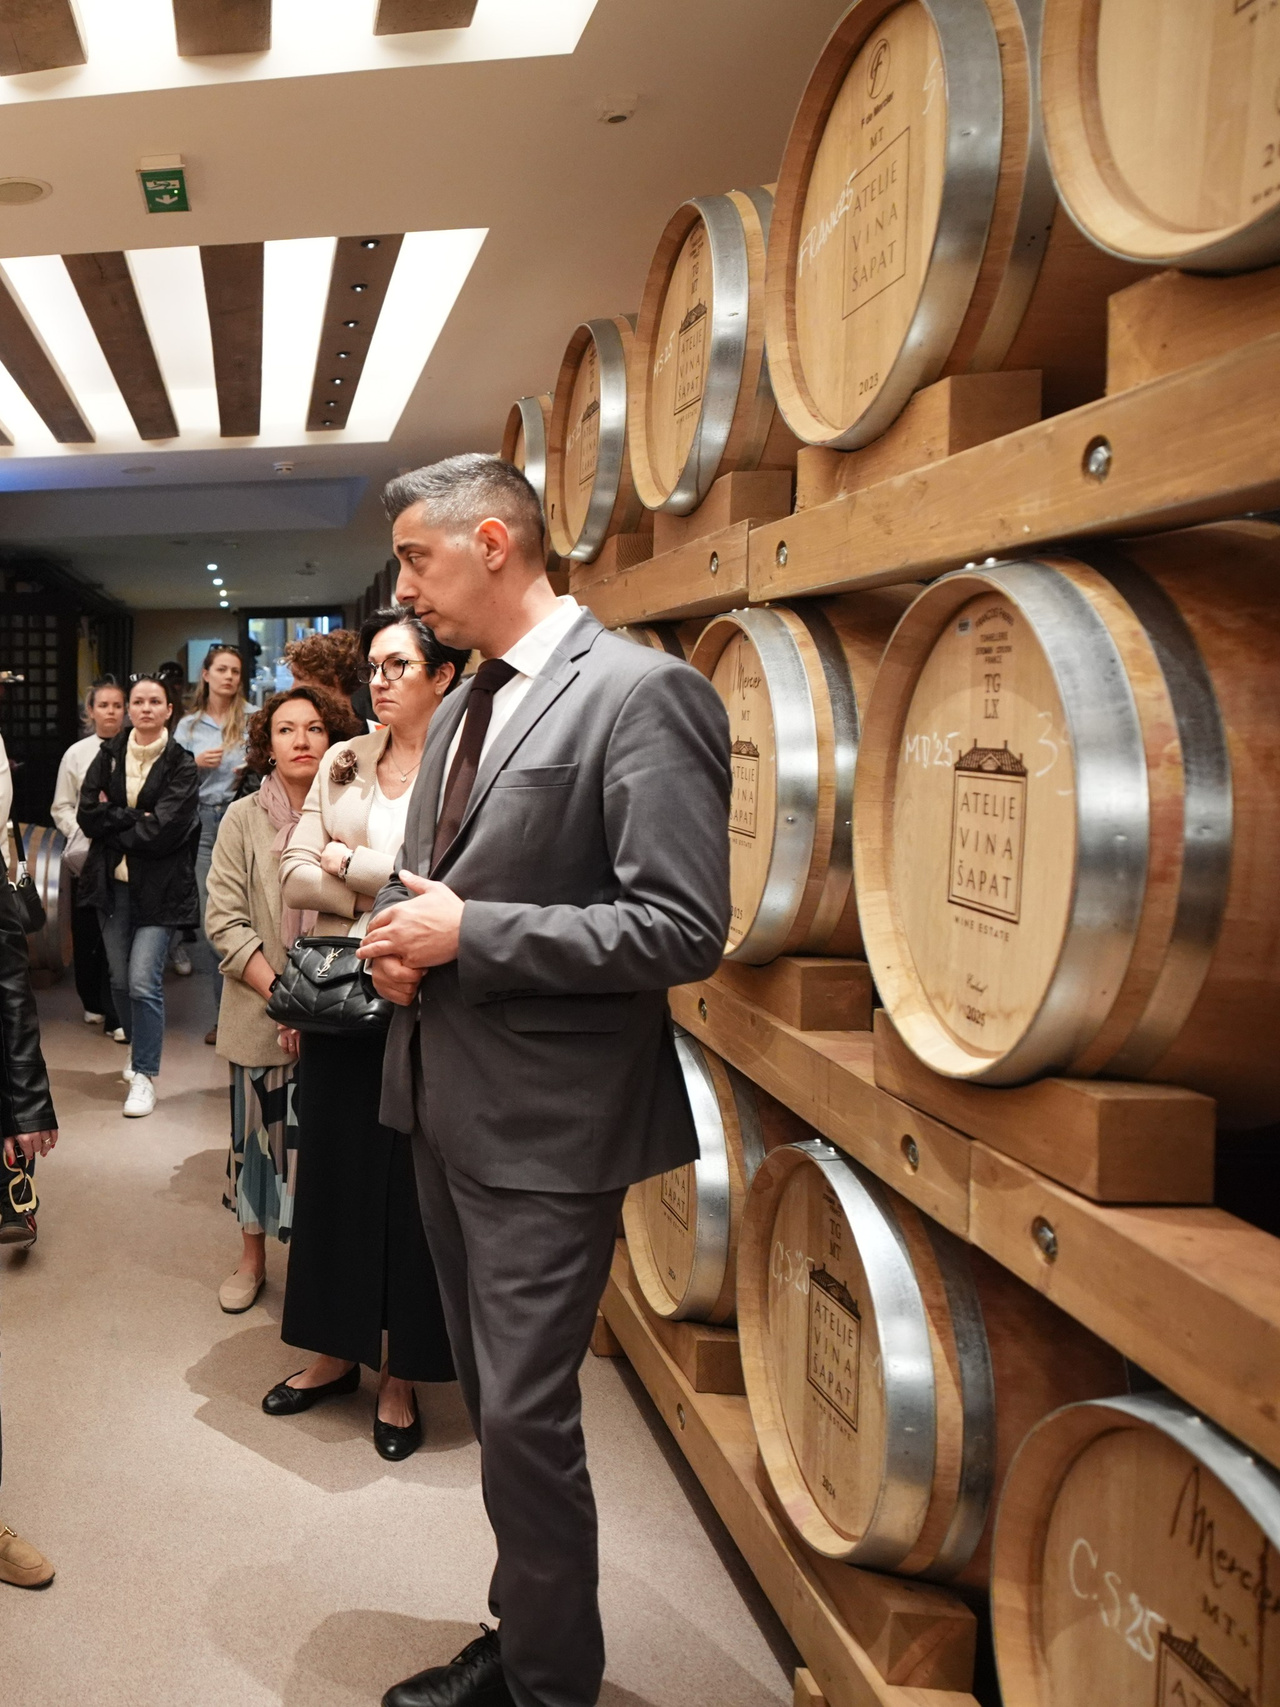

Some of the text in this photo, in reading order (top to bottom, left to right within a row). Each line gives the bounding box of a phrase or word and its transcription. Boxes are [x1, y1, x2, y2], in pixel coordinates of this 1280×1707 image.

[852, 203, 898, 253] VINA
[852, 240, 897, 292] ŠAPAT
[680, 354, 700, 378] VINA
[859, 373, 880, 396] 2023
[984, 673, 1001, 693] TG
[984, 699, 999, 719] LX
[960, 792, 1016, 823] ATELJE
[960, 827, 1013, 860] VINA
[957, 860, 1012, 899] ŠAPAT
[954, 915, 1010, 942] WINE ESTATE
[814, 1301, 854, 1348] ATELJE
[814, 1326, 852, 1379] VINA
[812, 1353, 852, 1407] ŠAPAT
